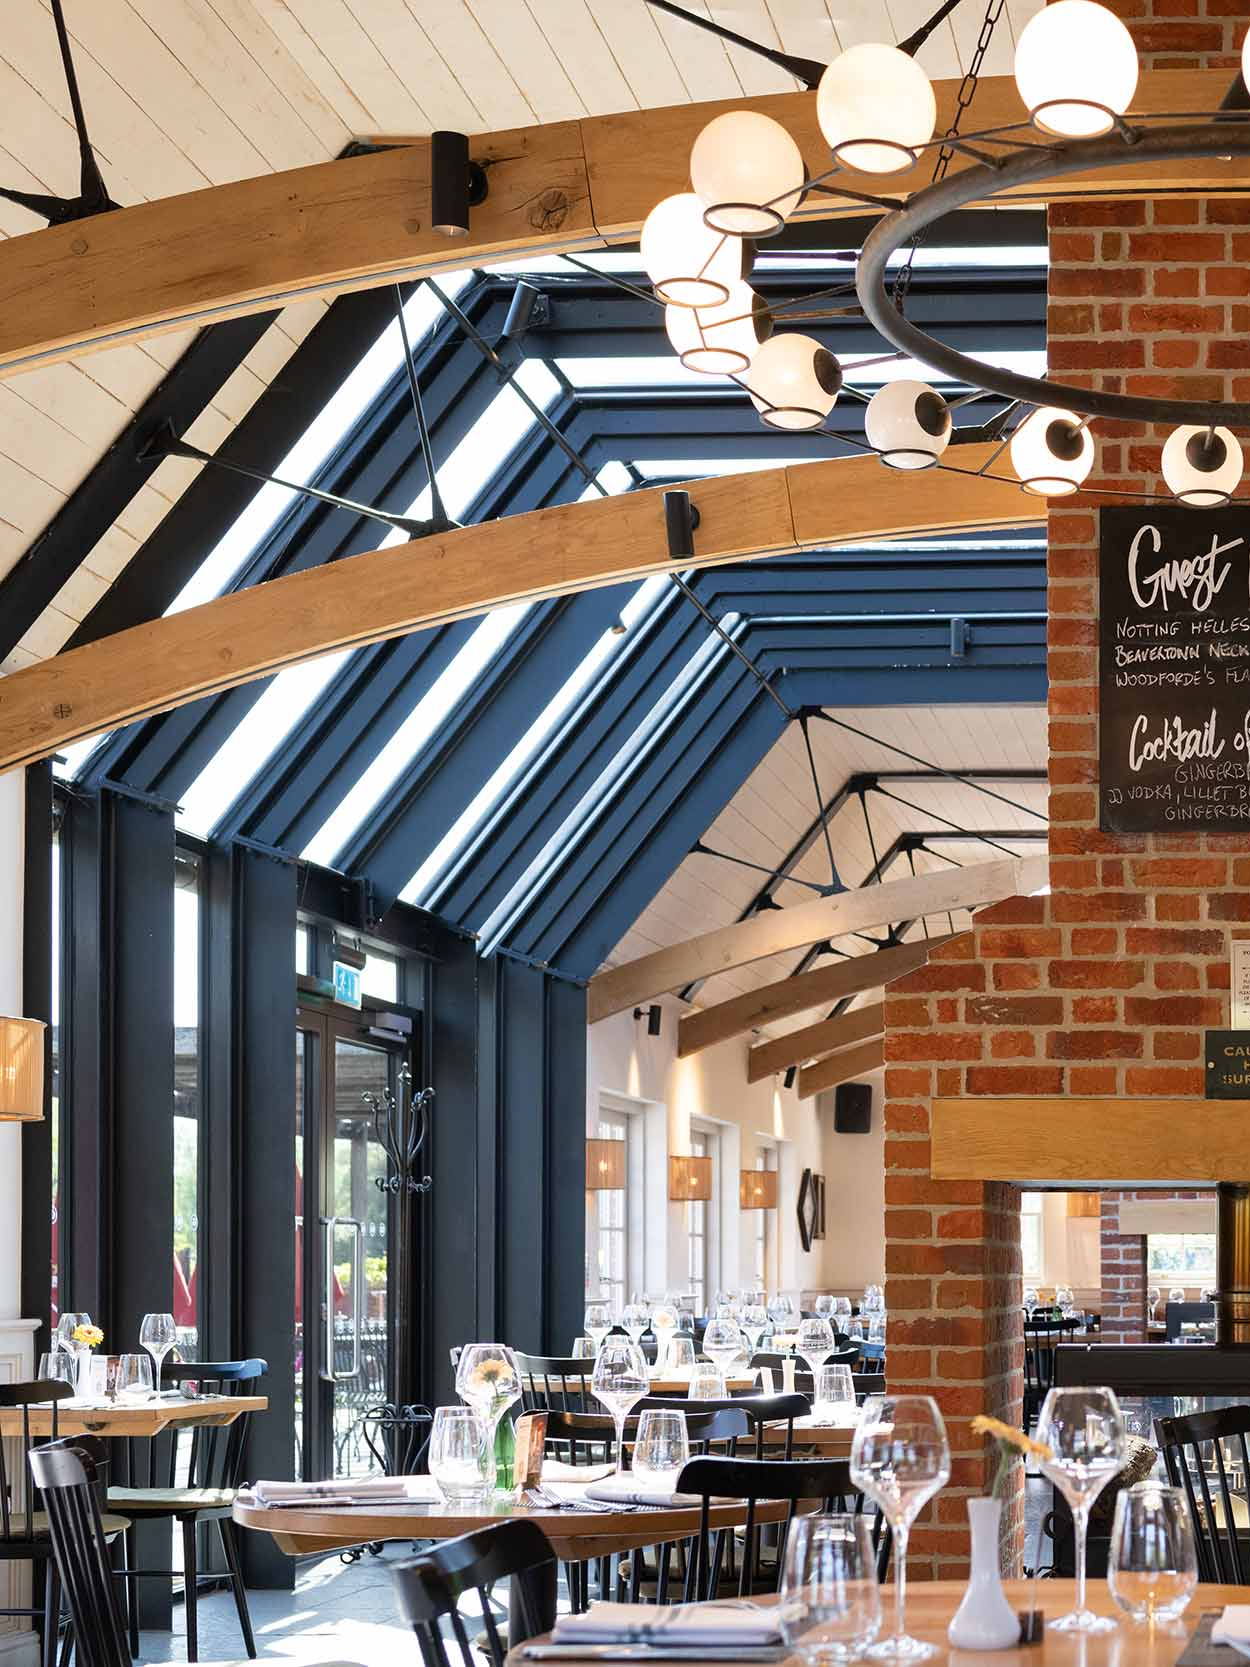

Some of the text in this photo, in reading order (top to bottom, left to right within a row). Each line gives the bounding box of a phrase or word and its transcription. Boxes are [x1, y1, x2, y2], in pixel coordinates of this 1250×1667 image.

[1127, 524, 1244, 612] Guest
[1116, 616, 1181, 638] NOTTING
[1114, 643, 1200, 667] BEAVERTOWN
[1209, 641, 1250, 659] NECK
[1129, 707, 1225, 772] Cocktail
